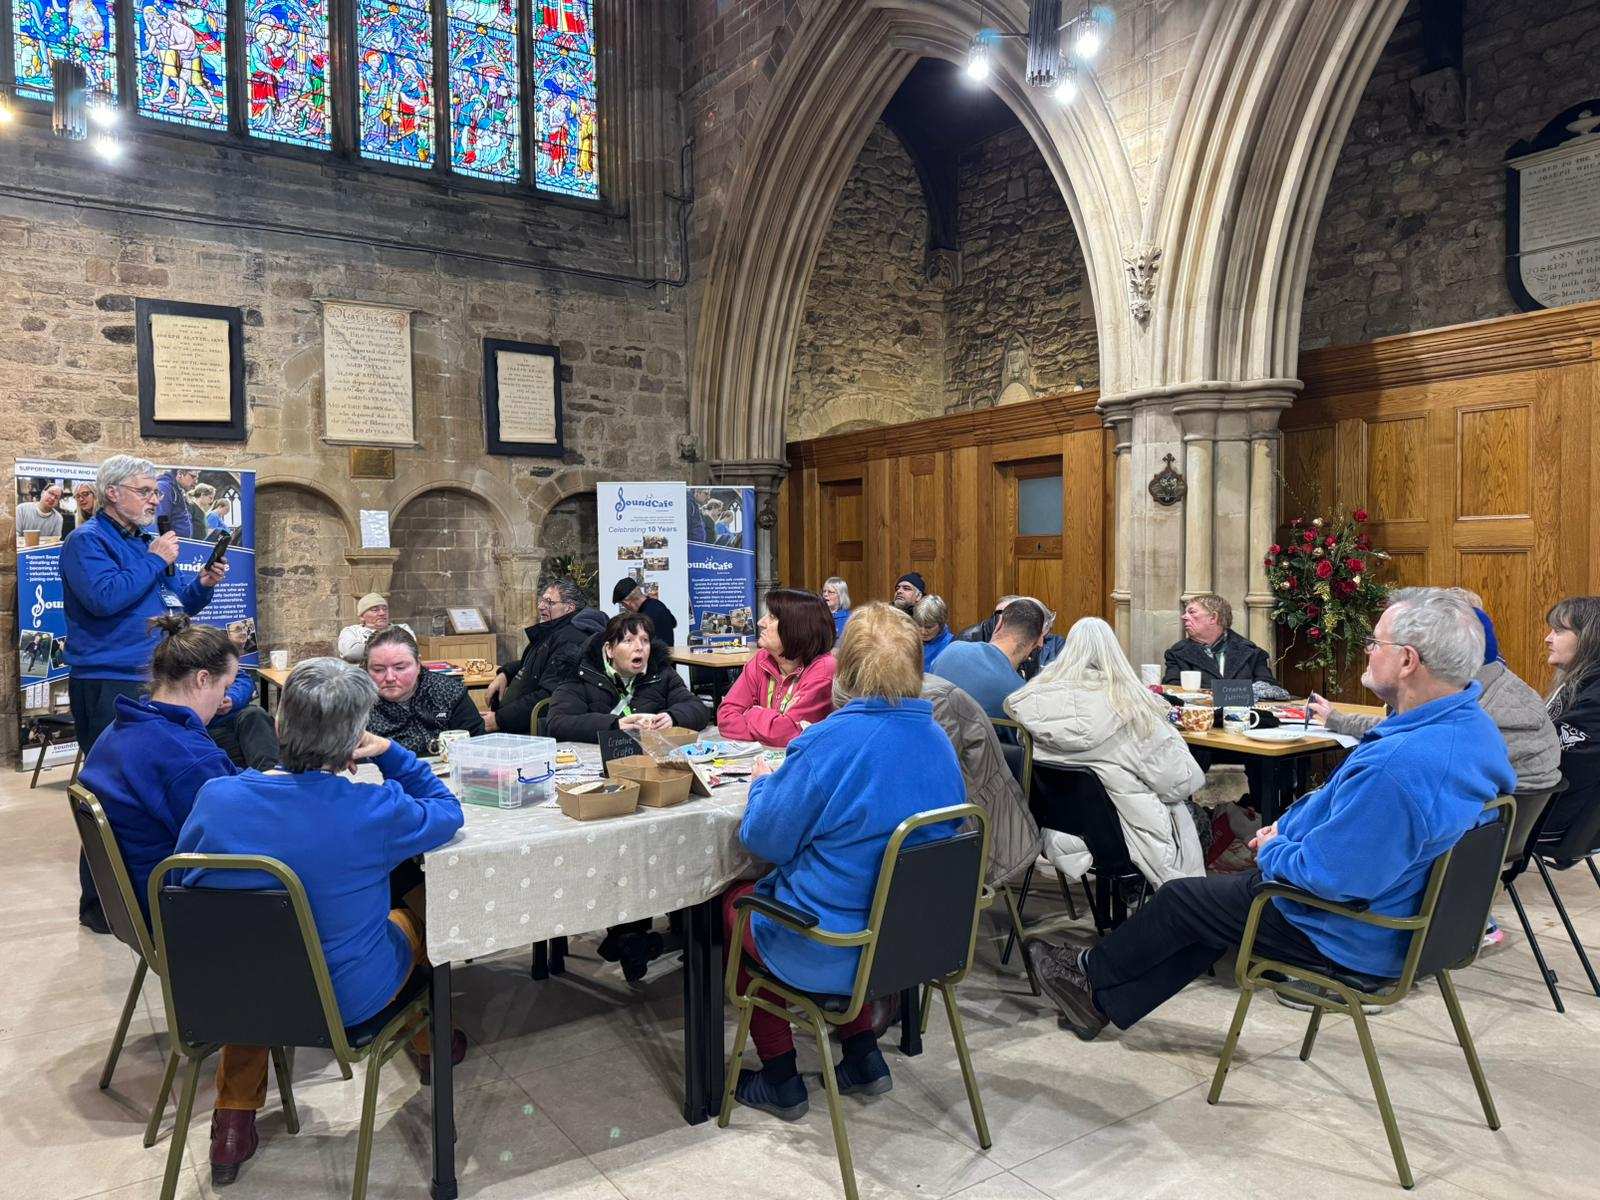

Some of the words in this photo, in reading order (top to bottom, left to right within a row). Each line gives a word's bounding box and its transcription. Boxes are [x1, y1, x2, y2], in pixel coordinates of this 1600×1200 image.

[1525, 262, 1568, 275] JOSEPH
[615, 486, 673, 521] SoundCafe
[608, 526, 646, 534] Celebrating
[688, 560, 734, 571] oundCafe
